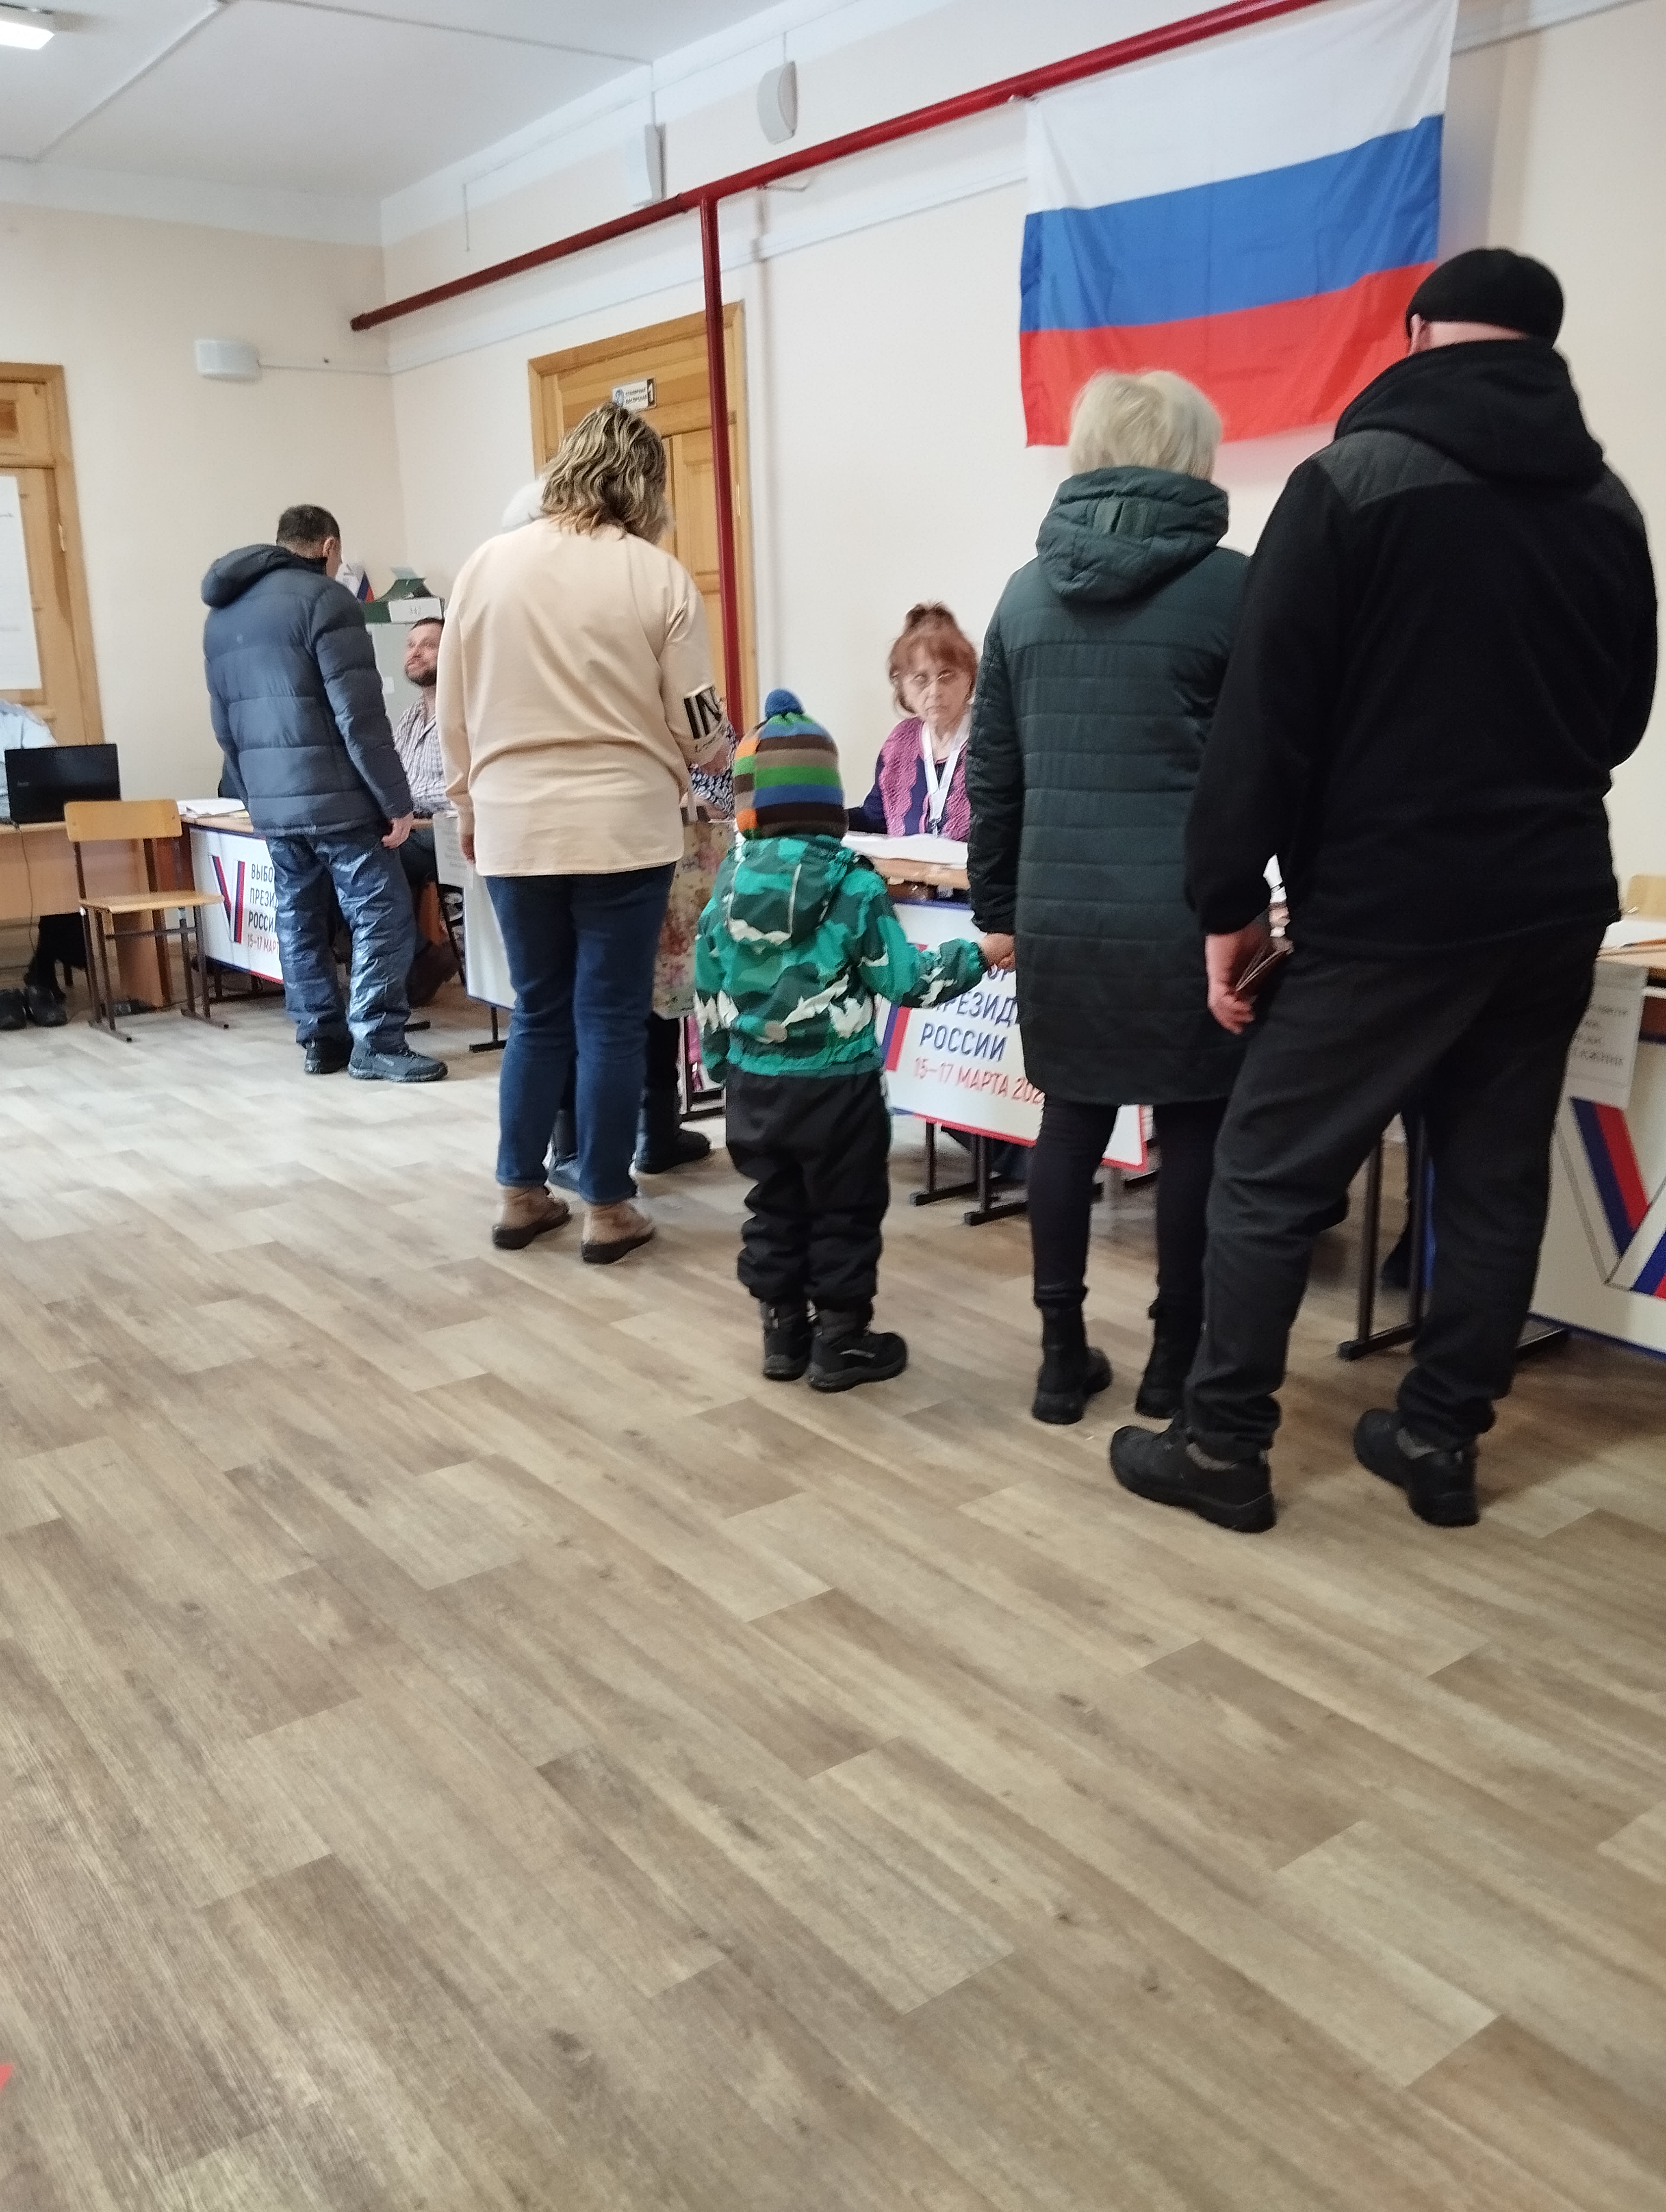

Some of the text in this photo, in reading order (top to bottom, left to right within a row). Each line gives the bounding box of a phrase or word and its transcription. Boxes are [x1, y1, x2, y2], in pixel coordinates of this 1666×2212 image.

[251, 863, 274, 883] ВЫБО
[248, 910, 276, 933] РОССИ
[920, 1023, 1008, 1062] РОССИИ
[956, 1065, 1009, 1097] МАРТА
